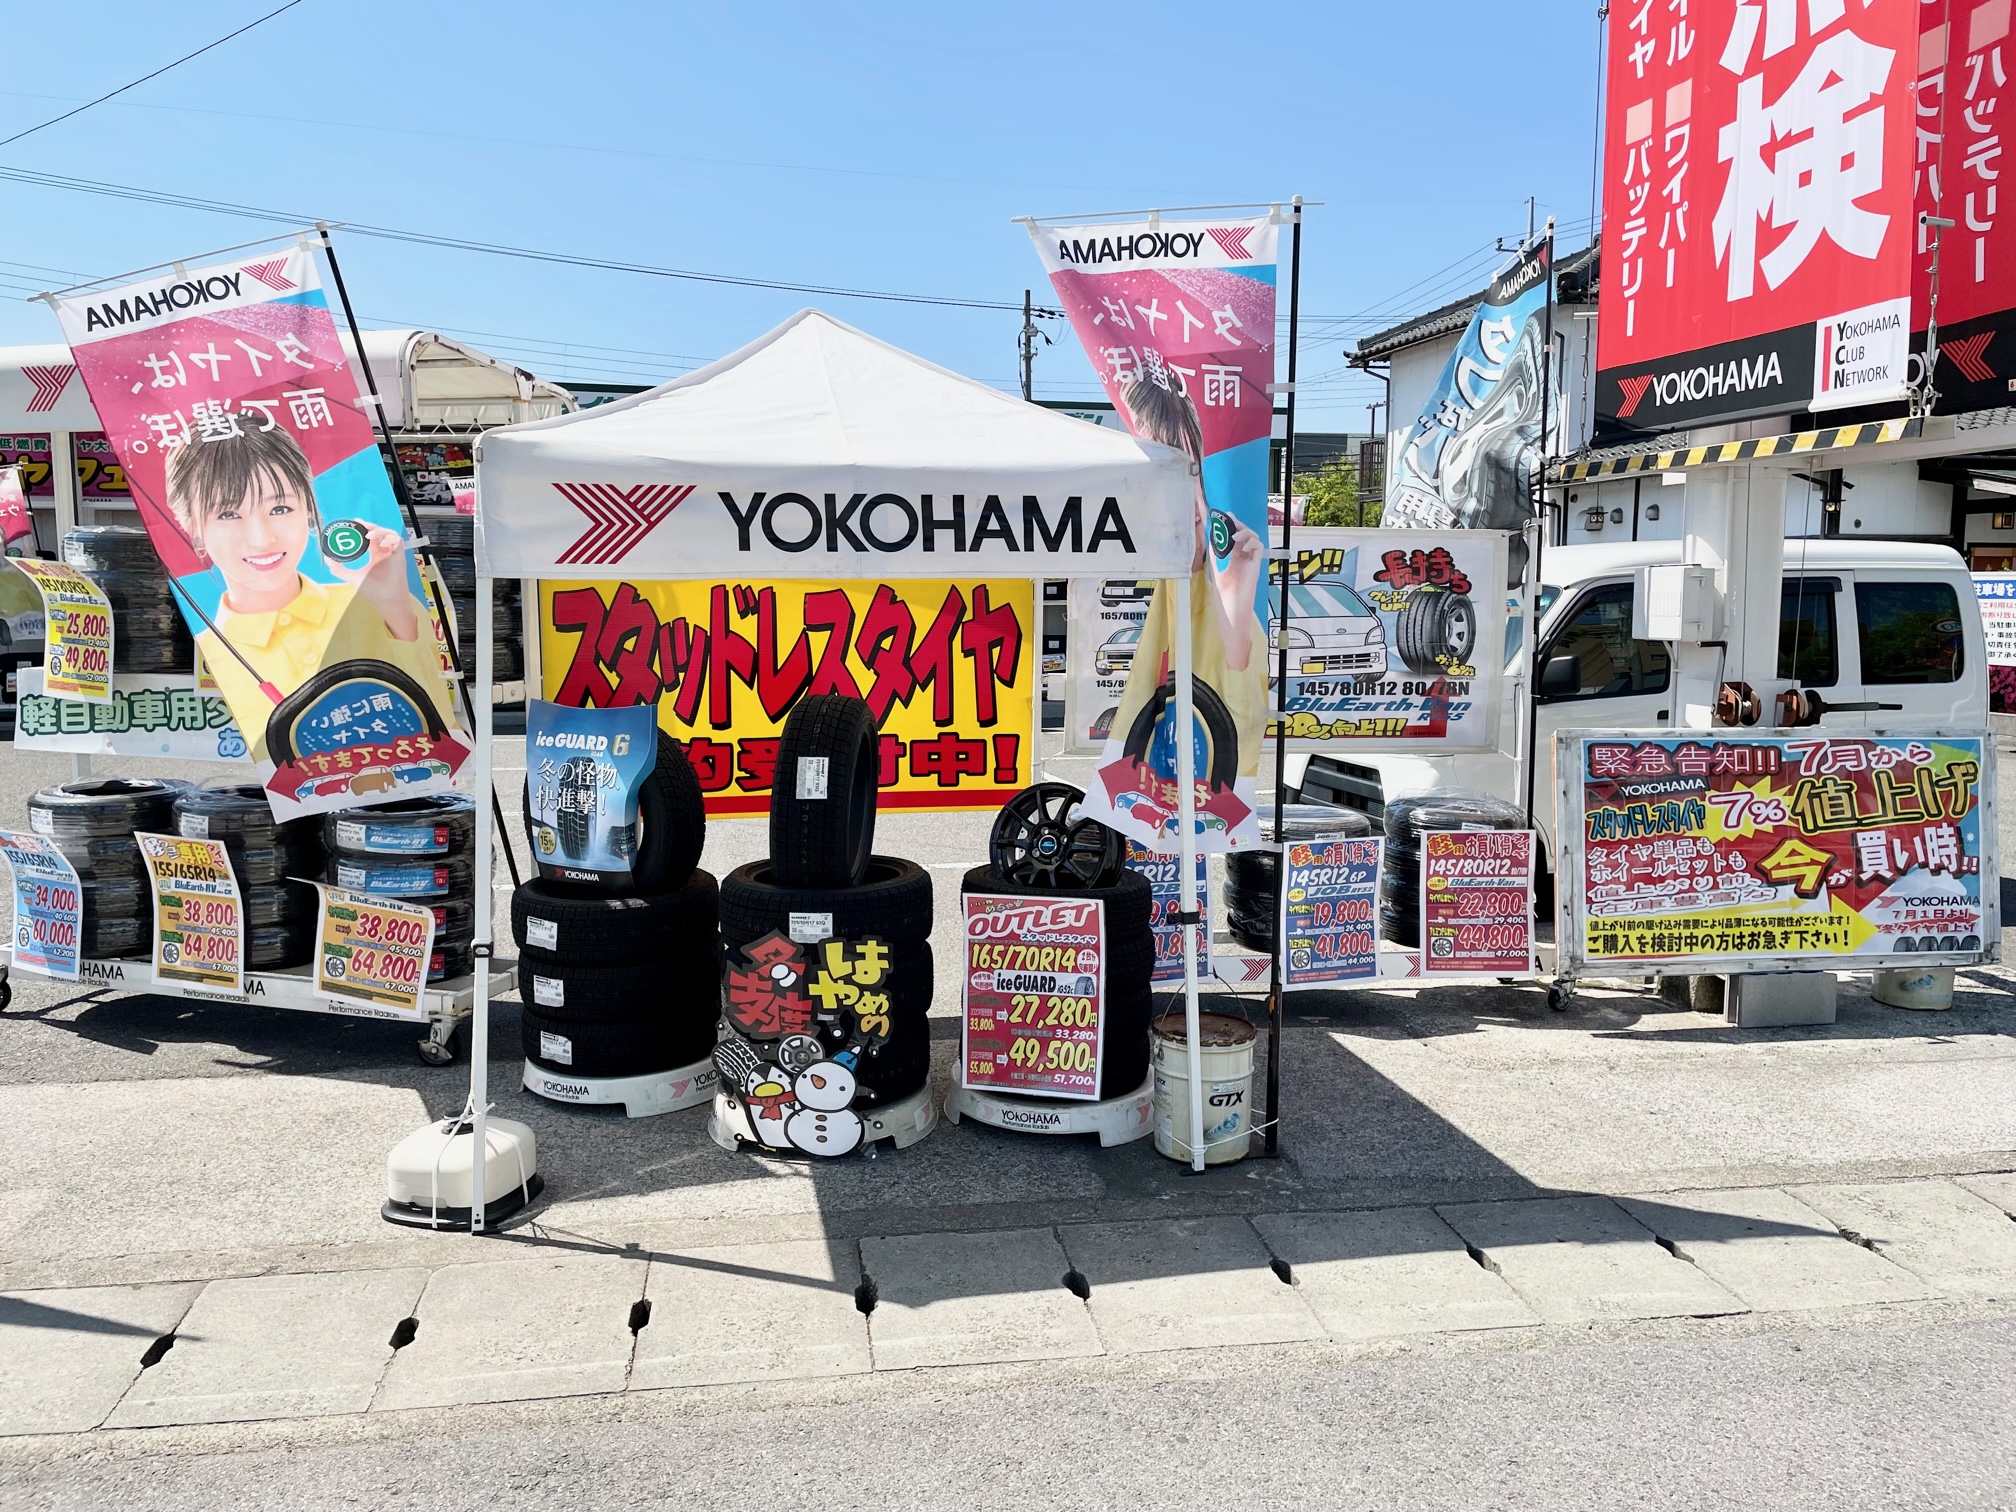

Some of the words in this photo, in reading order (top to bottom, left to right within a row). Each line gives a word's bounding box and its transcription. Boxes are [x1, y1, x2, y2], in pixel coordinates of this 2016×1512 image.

[1658, 123, 1690, 288] ワイパー
[1621, 138, 1654, 337] バッテリー
[1837, 314, 1901, 340] YOKOHAMA
[1835, 345, 1866, 364] CLUB
[1653, 351, 1783, 407] YOKOHAMA
[1834, 364, 1889, 389] NETWORK
[717, 491, 1137, 554] YOKOHAMA
[1373, 547, 1472, 594] 長持ち
[552, 583, 1023, 730] スタッドレスタイヤ
[1095, 679, 1128, 689] 145/8
[1296, 681, 1397, 697] 145/80R12
[1286, 697, 1473, 713] BluEarth-Van
[536, 730, 608, 751] iceGUARD
[611, 733, 632, 757] 6
[1786, 740, 1932, 775] 7月から
[537, 757, 620, 791] 冬の怪物、
[1594, 745, 1777, 775] 緊急告知!!
[535, 785, 607, 816] 快進撃!
[1621, 778, 1706, 797] YOKOHAMA
[1793, 762, 1978, 835] 値上げ
[1587, 799, 1706, 839] スタッドレスタイヤ
[1709, 794, 1786, 829] 7%
[1587, 838, 1715, 865] タイヤ単品も
[563, 869, 600, 882] YOKOHAMA
[1290, 867, 1350, 888] 145R12
[1350, 871, 1367, 883] 6P
[1429, 858, 1512, 875] 145/80R12
[1589, 852, 1748, 884] ホイールセットも
[1309, 884, 1352, 898] JOB
[1450, 878, 1516, 887] BluEarth-Van
[1586, 873, 1763, 902] 値上がり前、
[1589, 886, 1777, 917] 在庫豊富な
[1902, 896, 1980, 907] YOKOHAMA
[355, 912, 427, 947] 38,800円
[967, 902, 1096, 938] OUTLET
[1021, 932, 1098, 944] スタッドレスタイヤ
[1588, 929, 1849, 954] ご購入を検討中の方はお急ぎ下さい!
[351, 948, 421, 984] 64,800円
[971, 943, 1077, 973] 165/70R14
[996, 972, 1057, 993] iceGUARD
[1008, 994, 1098, 1029] 27,280円
[1008, 1037, 1097, 1074] 49,500円
[542, 1079, 590, 1096] YOKOHAMA
[1209, 1089, 1245, 1108] GTX
[1001, 1108, 1062, 1126] YOKOHAMA
